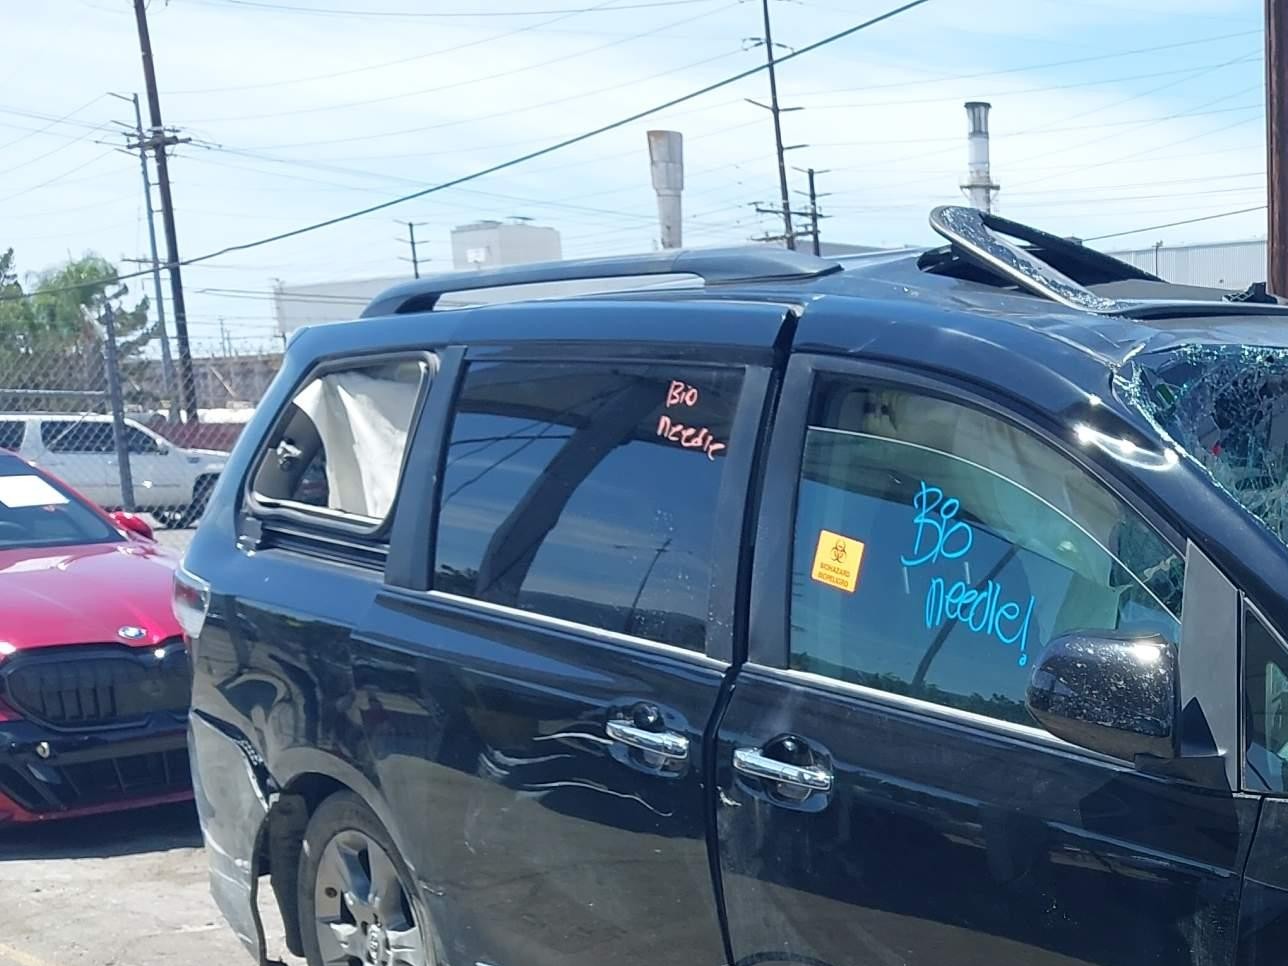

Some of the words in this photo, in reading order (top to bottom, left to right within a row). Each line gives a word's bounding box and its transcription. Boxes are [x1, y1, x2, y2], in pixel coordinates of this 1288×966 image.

[666, 380, 698, 408] Bio
[656, 415, 726, 461] needle
[901, 480, 972, 566] Bio
[926, 577, 1035, 666] needle!
